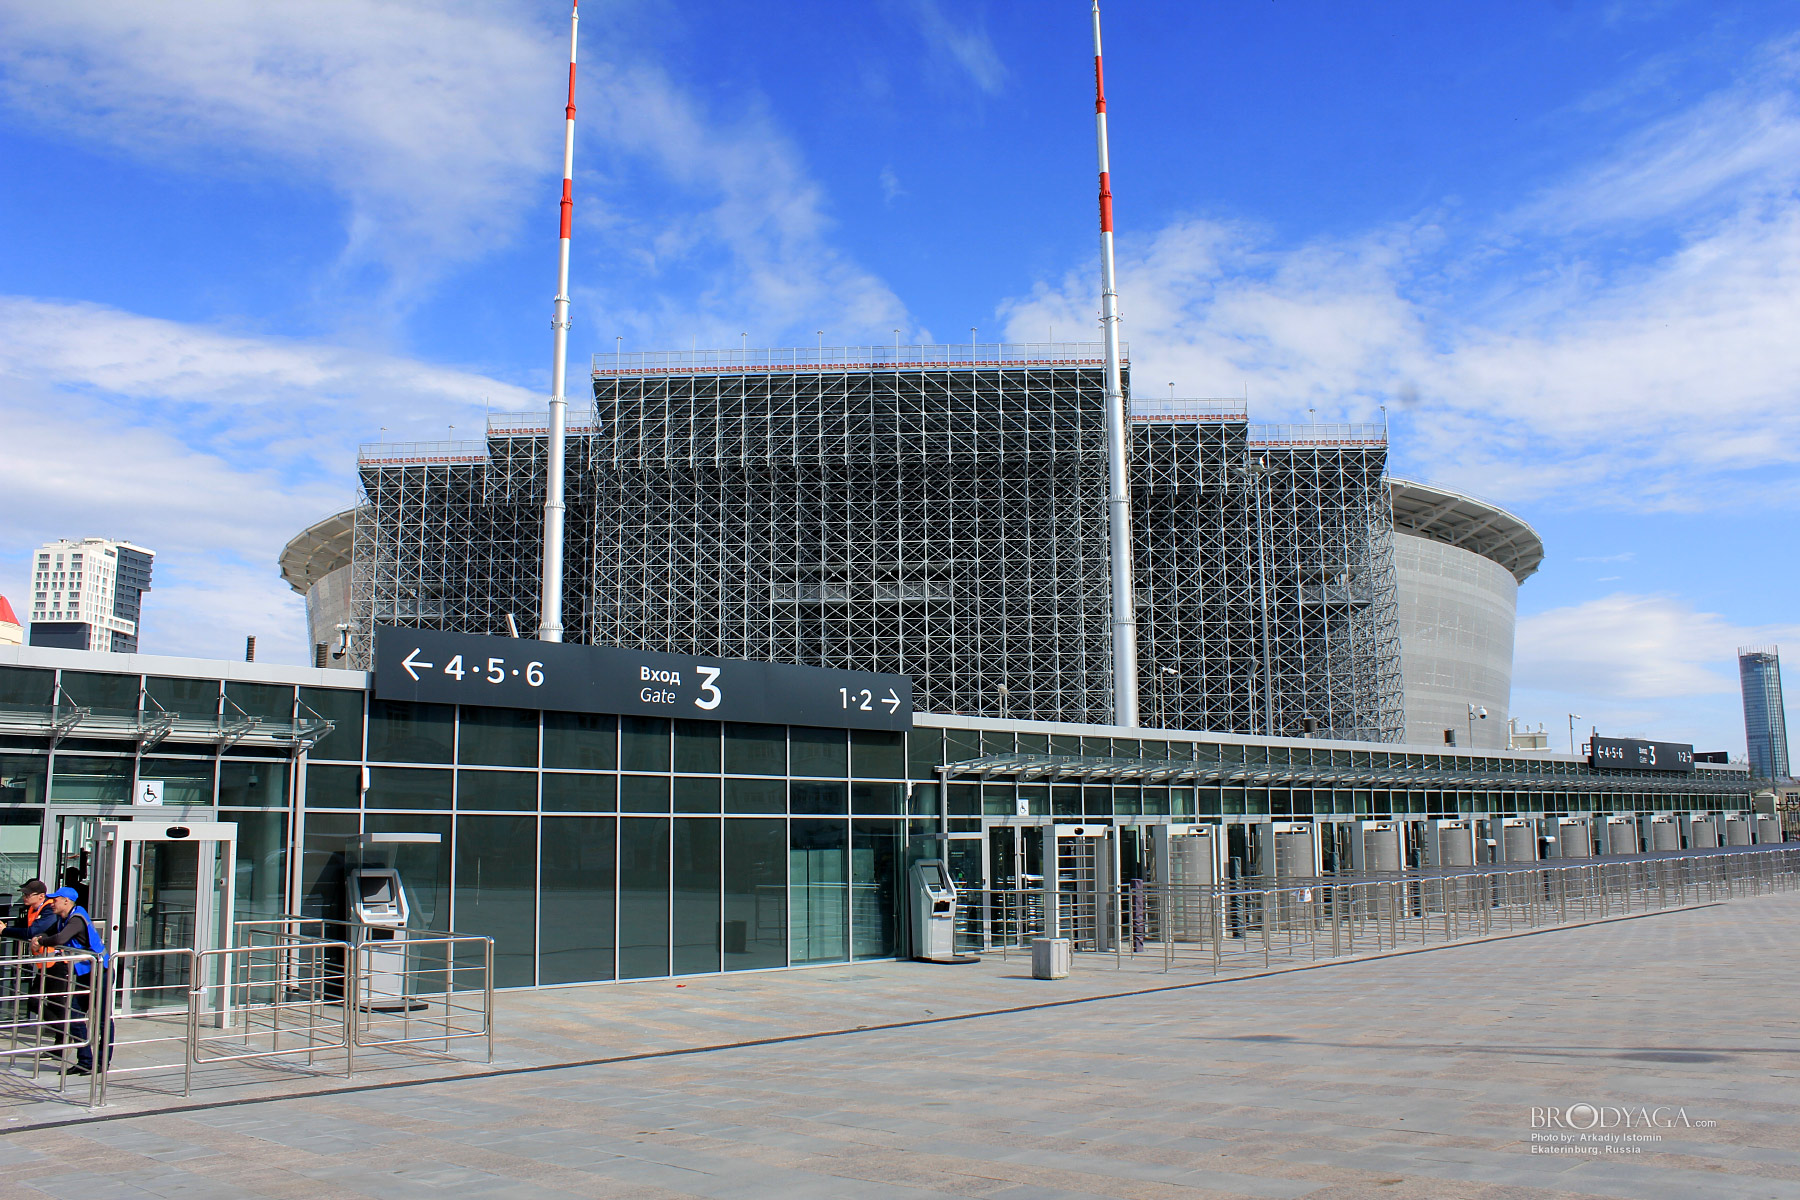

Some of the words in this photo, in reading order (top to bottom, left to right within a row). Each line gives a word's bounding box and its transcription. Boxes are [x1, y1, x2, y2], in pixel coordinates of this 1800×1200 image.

[640, 665, 681, 686] Вход
[640, 687, 676, 704] Gate
[694, 665, 722, 711] 3
[1648, 745, 1657, 766] 3
